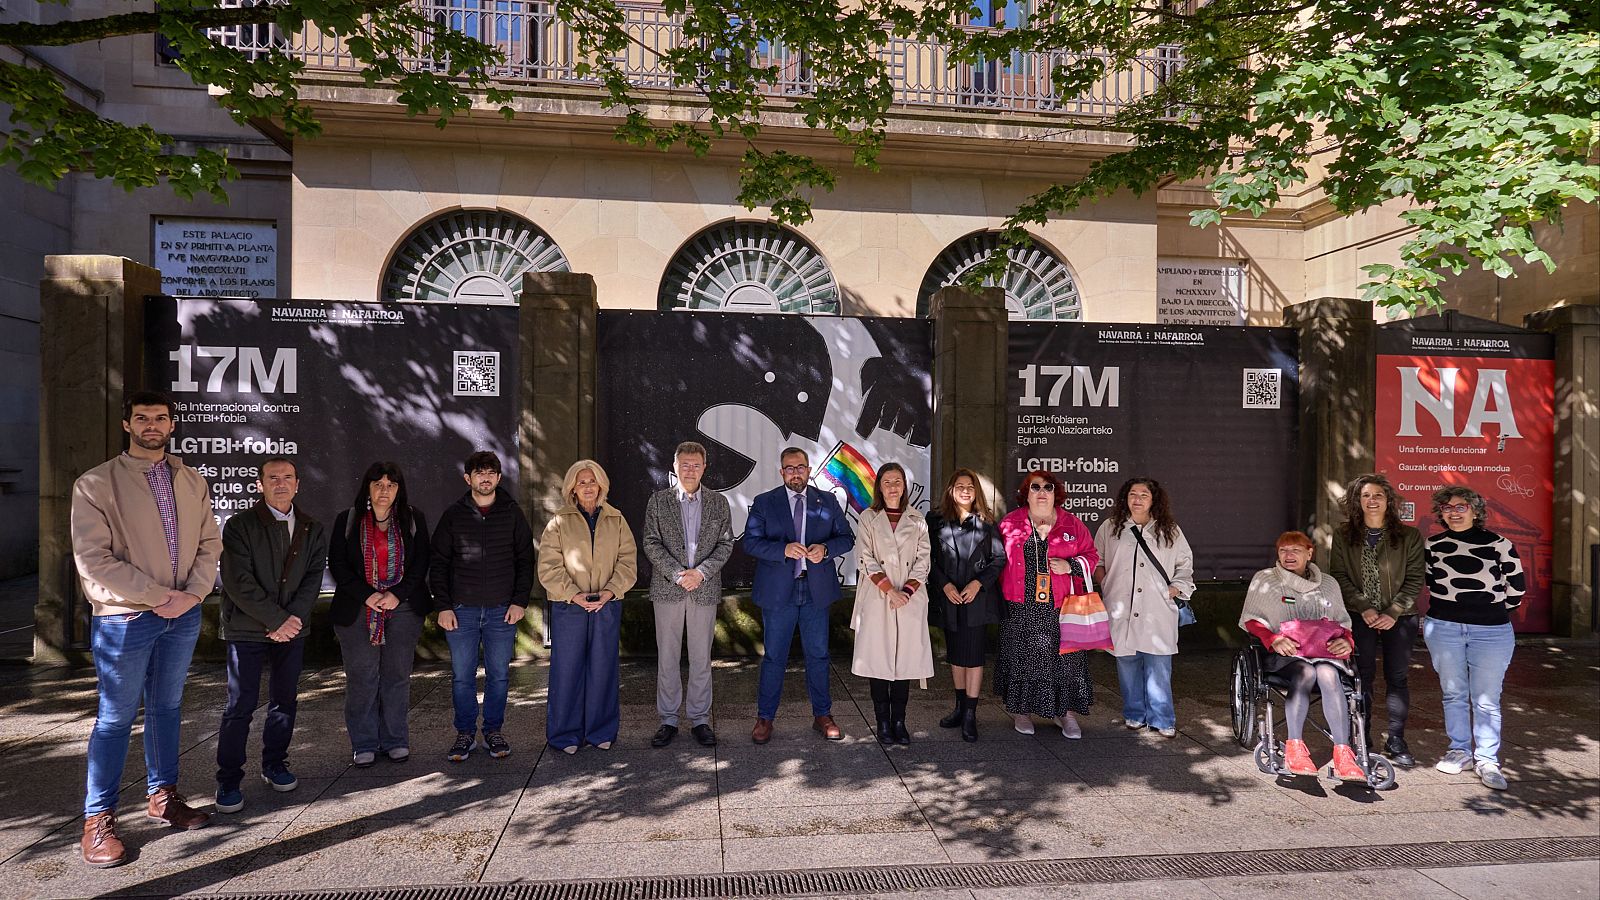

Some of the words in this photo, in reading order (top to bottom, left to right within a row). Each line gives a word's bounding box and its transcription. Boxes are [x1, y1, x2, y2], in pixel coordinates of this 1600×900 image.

[211, 232, 252, 240] PALACIO
[192, 243, 234, 251] PRIMITIVA
[168, 254, 186, 262] FVE
[190, 254, 250, 263] INAVGVRADO
[187, 266, 246, 274] MDCCCXLVII
[161, 276, 206, 284] CONFORME
[272, 308, 327, 318] NAVARRA
[342, 310, 404, 320] NAFARROA
[1098, 330, 1142, 340] NAVARRA
[1154, 332, 1203, 340] NAFARROA
[1412, 337, 1452, 346] NAVARRA
[1464, 339, 1510, 348] NAFARROA
[169, 344, 297, 394] 17M
[1018, 364, 1120, 408] 17M
[190, 402, 260, 412] Internacional
[263, 404, 300, 412] contra
[1396, 366, 1524, 438] NA
[182, 413, 247, 423] LGTBI+fobia
[1018, 415, 1088, 424] LGTBI+fobiaren
[1018, 426, 1056, 434] aurkako
[1058, 426, 1113, 435] Nazioarteko
[170, 437, 298, 454] LGTBI+fobia
[1018, 436, 1047, 446] Eguna
[1018, 458, 1119, 473] LGTBI+fobia
[1428, 464, 1457, 473] egiteko
[1458, 464, 1482, 473] dugun
[213, 483, 243, 496] que
[1062, 496, 1114, 510] geriago
